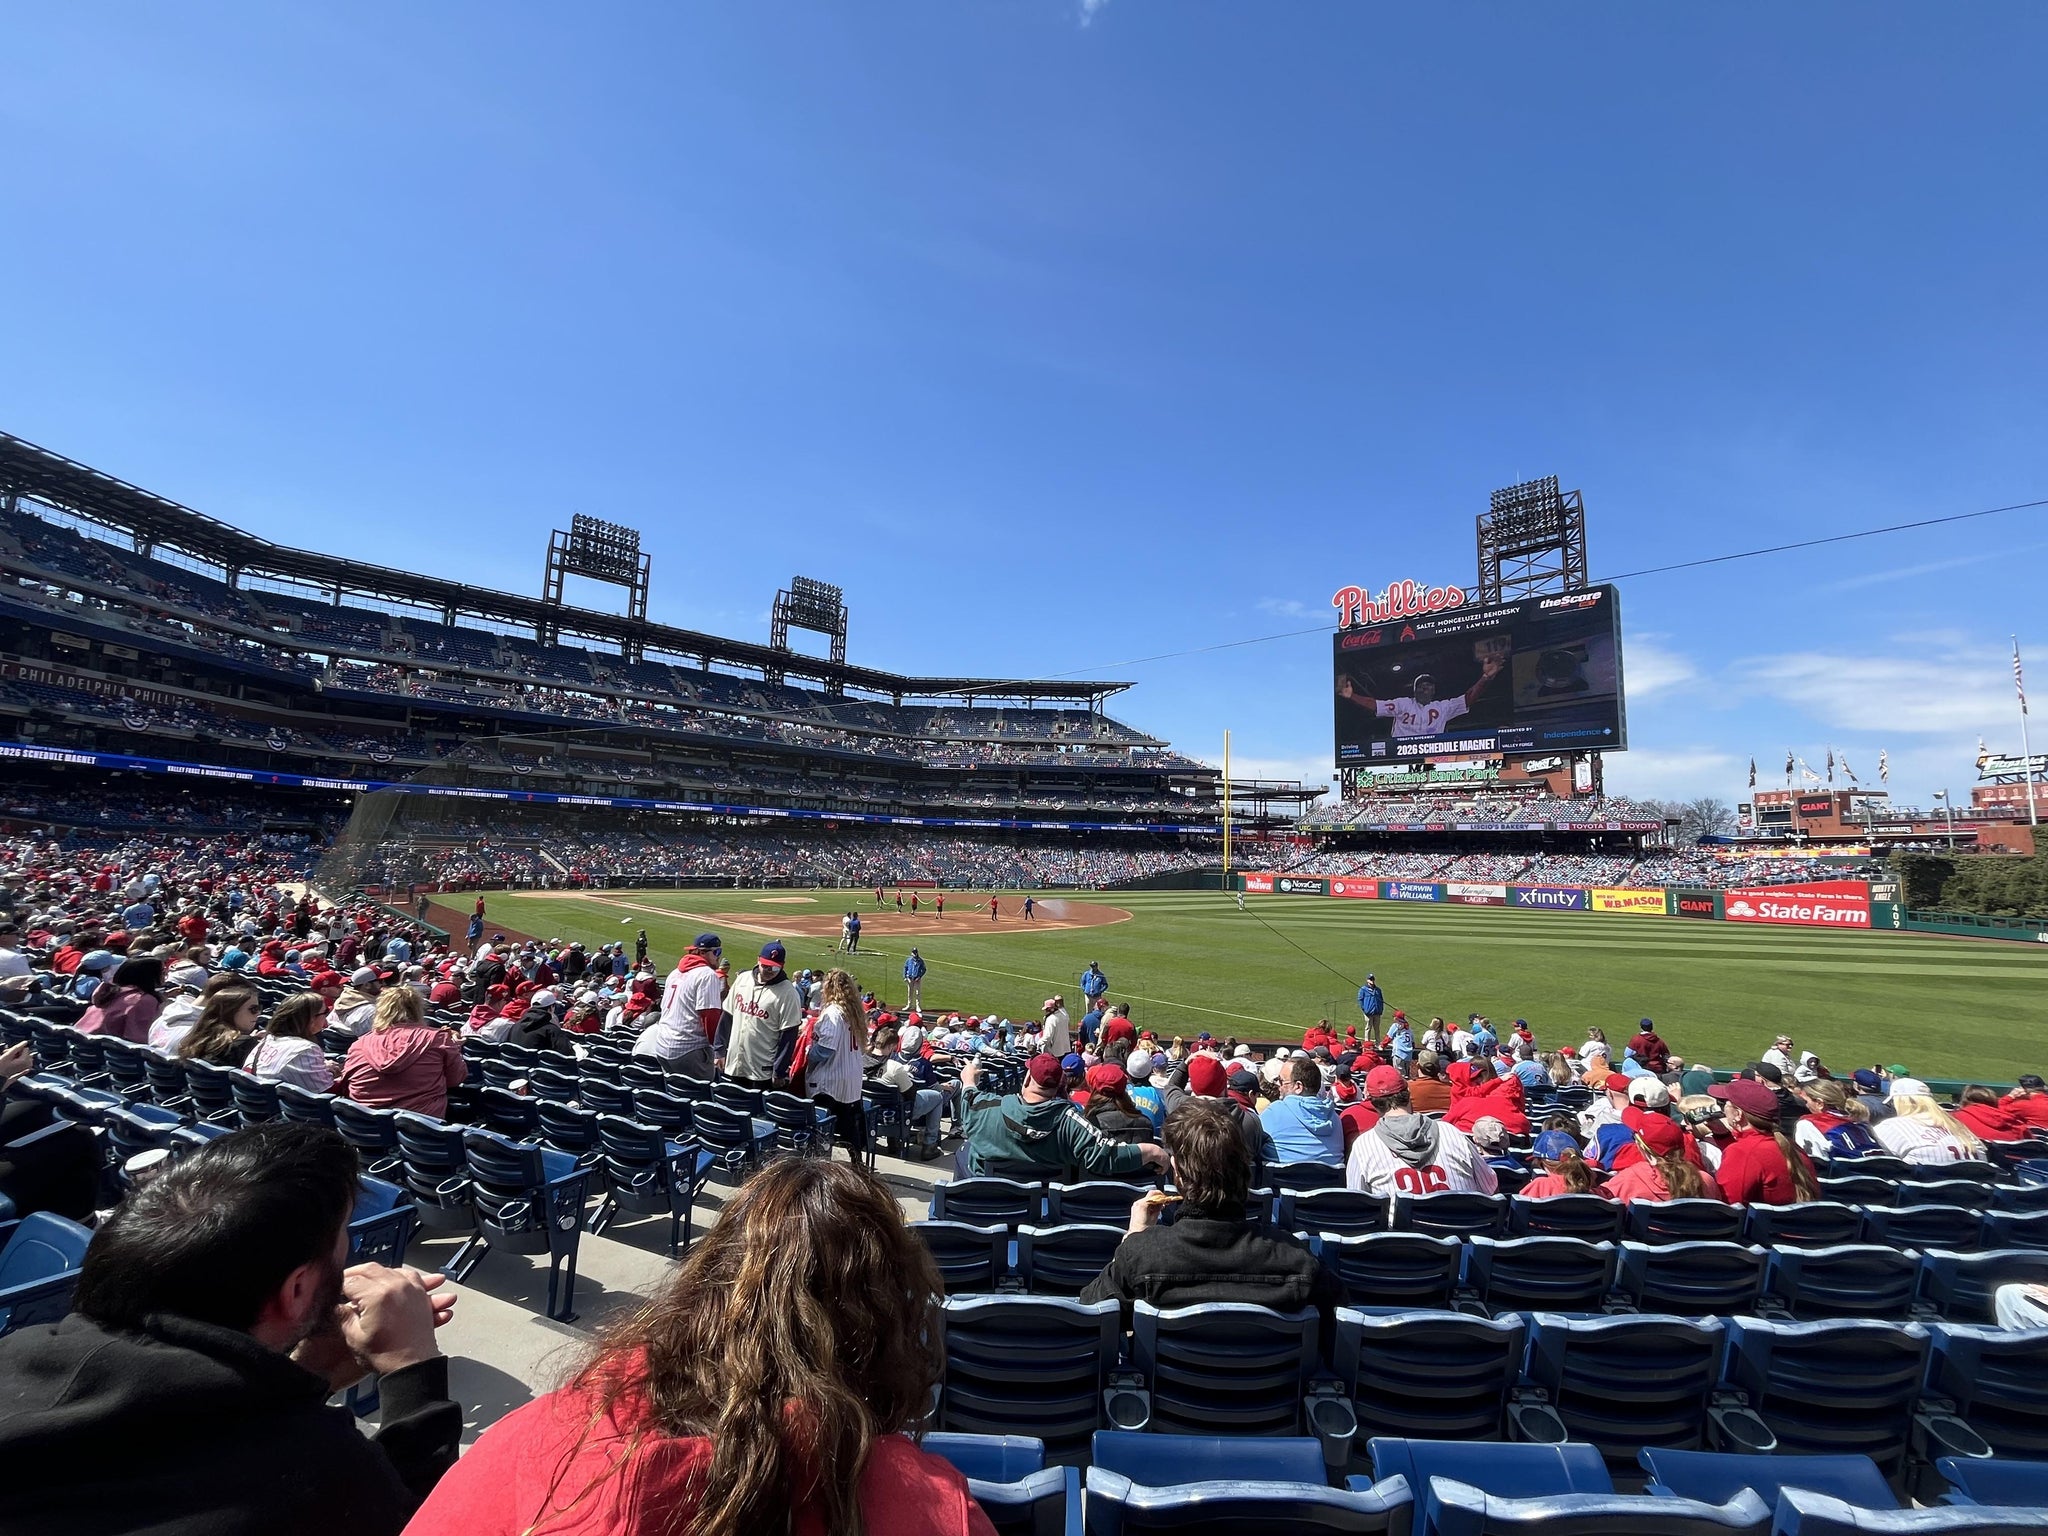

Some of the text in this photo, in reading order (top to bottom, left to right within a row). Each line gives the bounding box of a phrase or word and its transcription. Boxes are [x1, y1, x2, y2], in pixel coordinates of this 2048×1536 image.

[1332, 579, 1465, 628] Phillies
[1539, 591, 1602, 609] theScore
[1416, 607, 1520, 630] SALTZ MONGELUZZI BENDESKY
[1435, 619, 1500, 634] INJURY LAWYERS
[19, 667, 126, 697] PHILADELPHIA
[1402, 712, 1416, 725] 21
[1543, 729, 1601, 739] Independence
[1397, 738, 1495, 756] 2026 SCHEDULE MAGNET
[0, 747, 21, 757] 2026
[22, 750, 64, 761] SCHEDULE
[64, 754, 96, 765] MAGNET
[1375, 767, 1499, 784] Citizens Bank Park
[1800, 802, 1830, 811] GIANT
[1247, 880, 1272, 891] Wawa
[1291, 880, 1322, 889] NovaCare
[1400, 883, 1433, 892] SHERWIN
[1457, 885, 1495, 896] Yuengling
[1464, 896, 1489, 904] LAGER
[1519, 888, 1577, 907] xfinity
[1680, 900, 1714, 913] GIANT
[1892, 904, 1900, 929] 409
[667, 984, 678, 1009] 7
[735, 993, 770, 1020] Phillies
[1404, 1032, 1411, 1043] 5
[1435, 1042, 1442, 1052] 6
[1534, 1074, 1544, 1084] 3
